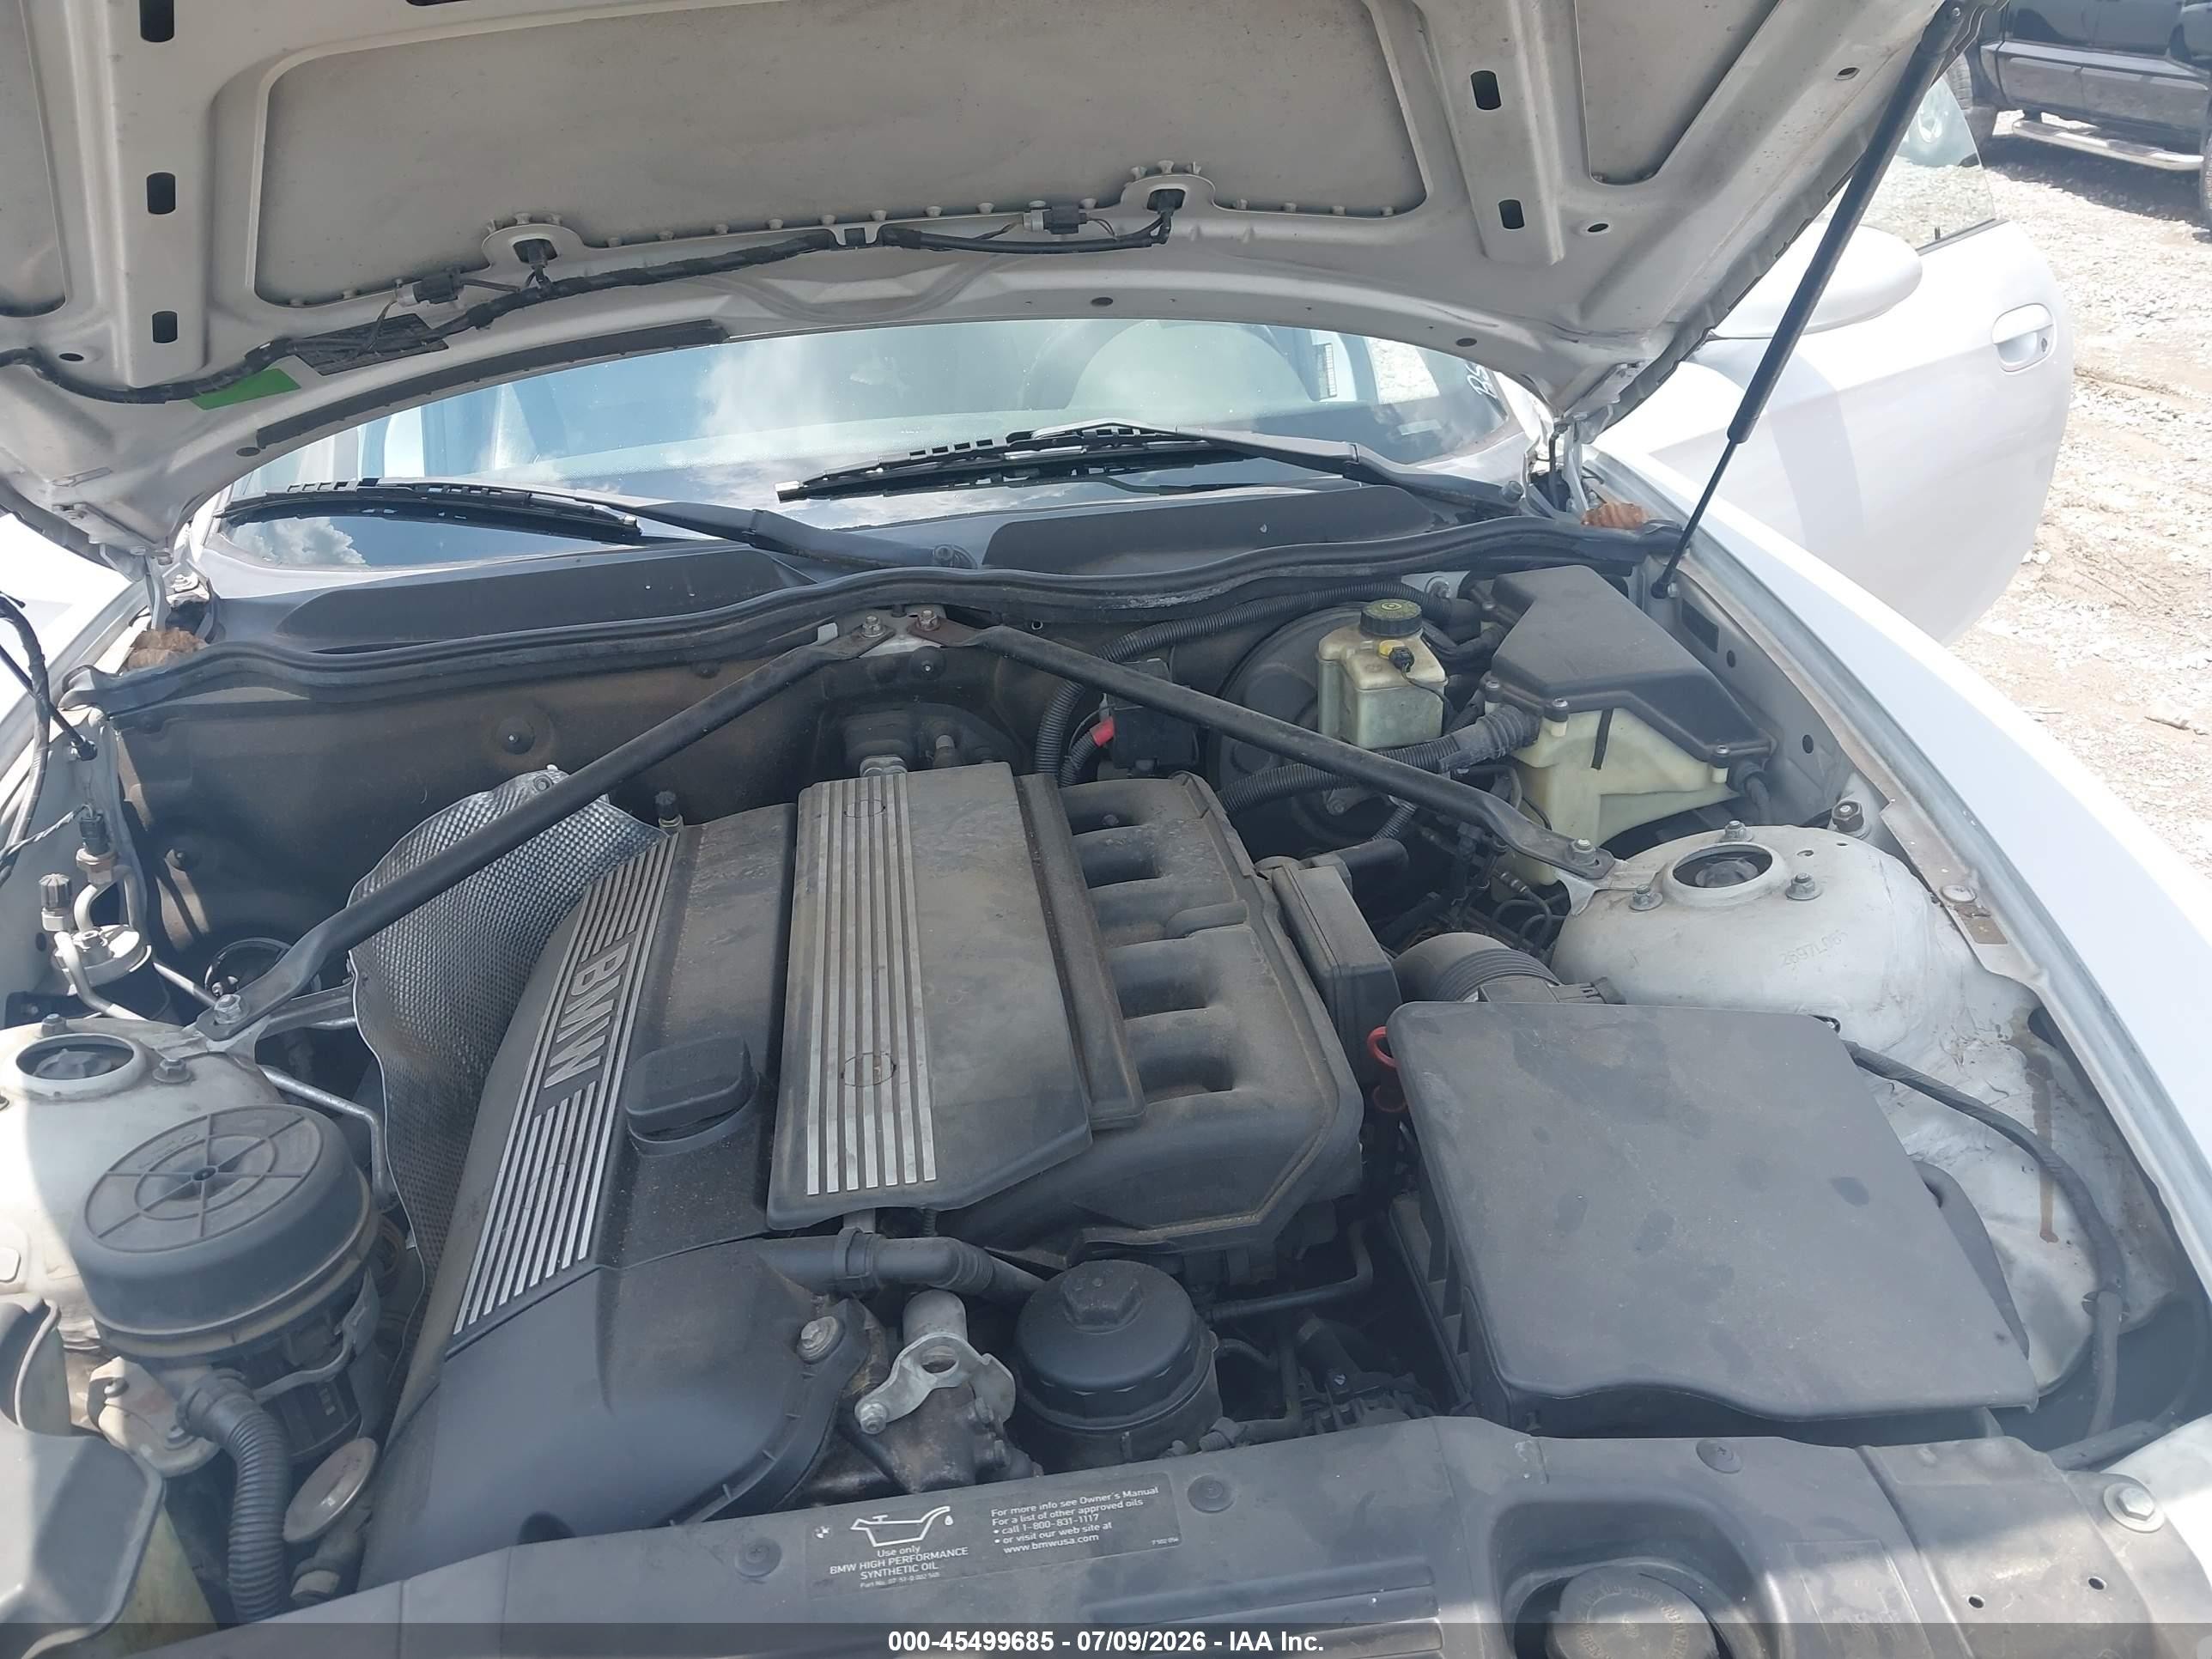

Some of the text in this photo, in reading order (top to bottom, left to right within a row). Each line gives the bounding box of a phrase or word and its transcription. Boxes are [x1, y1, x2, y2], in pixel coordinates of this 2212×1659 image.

[544, 943, 629, 1089] BMW
[991, 1486, 1159, 1517] For more info see Owner's Manual
[992, 1517, 1010, 1526] For
[1020, 1510, 1036, 1522] list
[1037, 1509, 1048, 1520] of
[1049, 1507, 1075, 1519] other
[1078, 1501, 1124, 1516] approved
[1126, 1498, 1144, 1508] oils
[1001, 1513, 1100, 1535] call 1-800-831-1117
[1002, 1521, 1113, 1544] or visit our web site at
[877, 1545, 921, 1558] Use only
[1003, 1534, 1099, 1554] www.bmwusa.com
[830, 1547, 969, 1575] BMW HIGH PERFORMANCE
[860, 1561, 939, 1580] SYNTHETIC OIL
